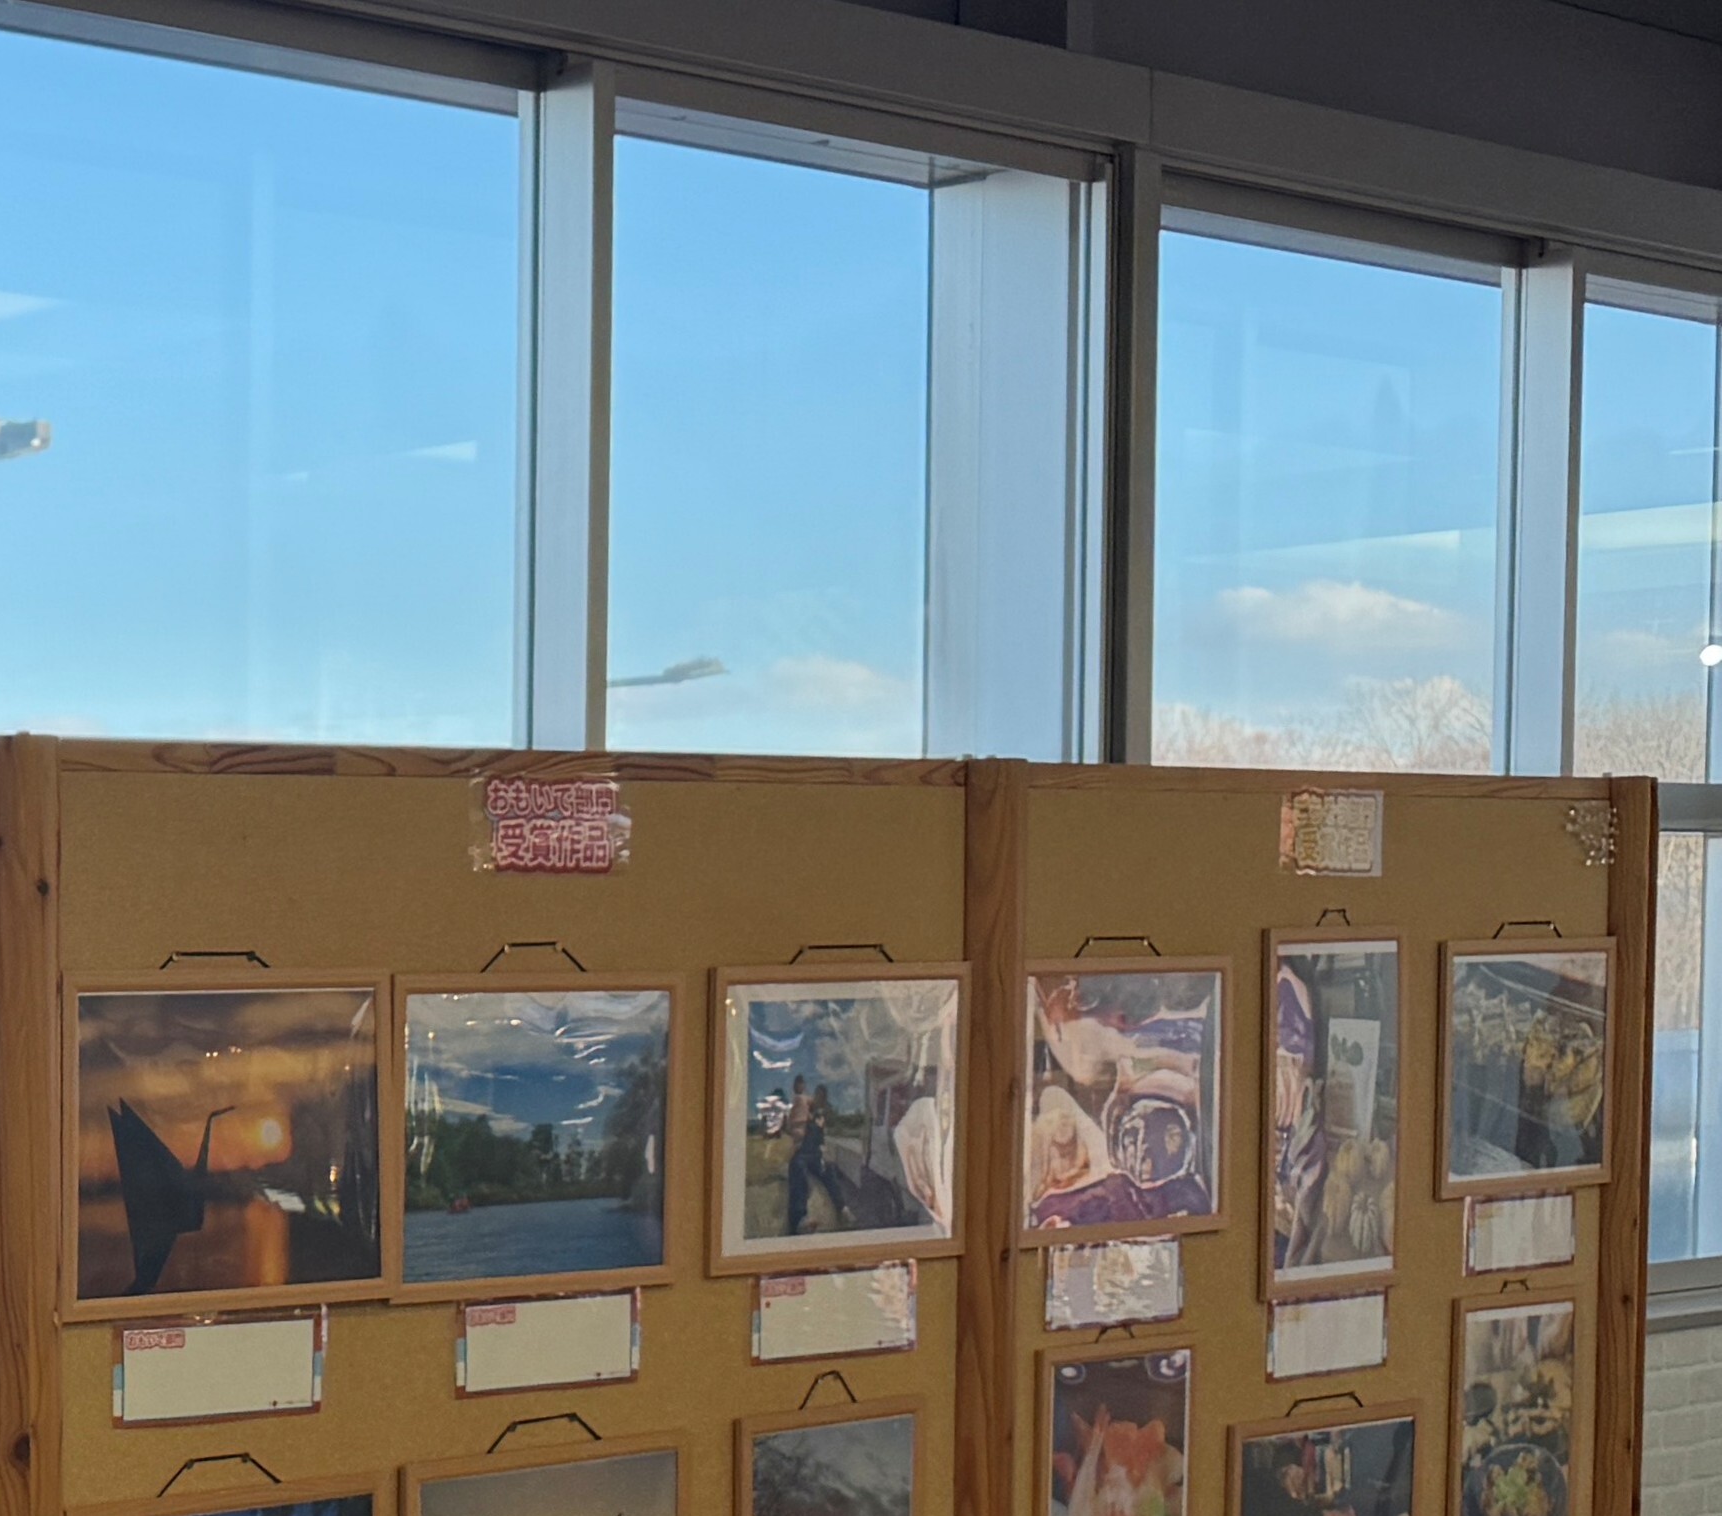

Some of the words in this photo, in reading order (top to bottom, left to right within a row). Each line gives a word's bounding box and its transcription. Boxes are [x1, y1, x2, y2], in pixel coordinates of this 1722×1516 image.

[486, 779, 617, 817] おもいで部門
[496, 818, 611, 867] 受賞作品
